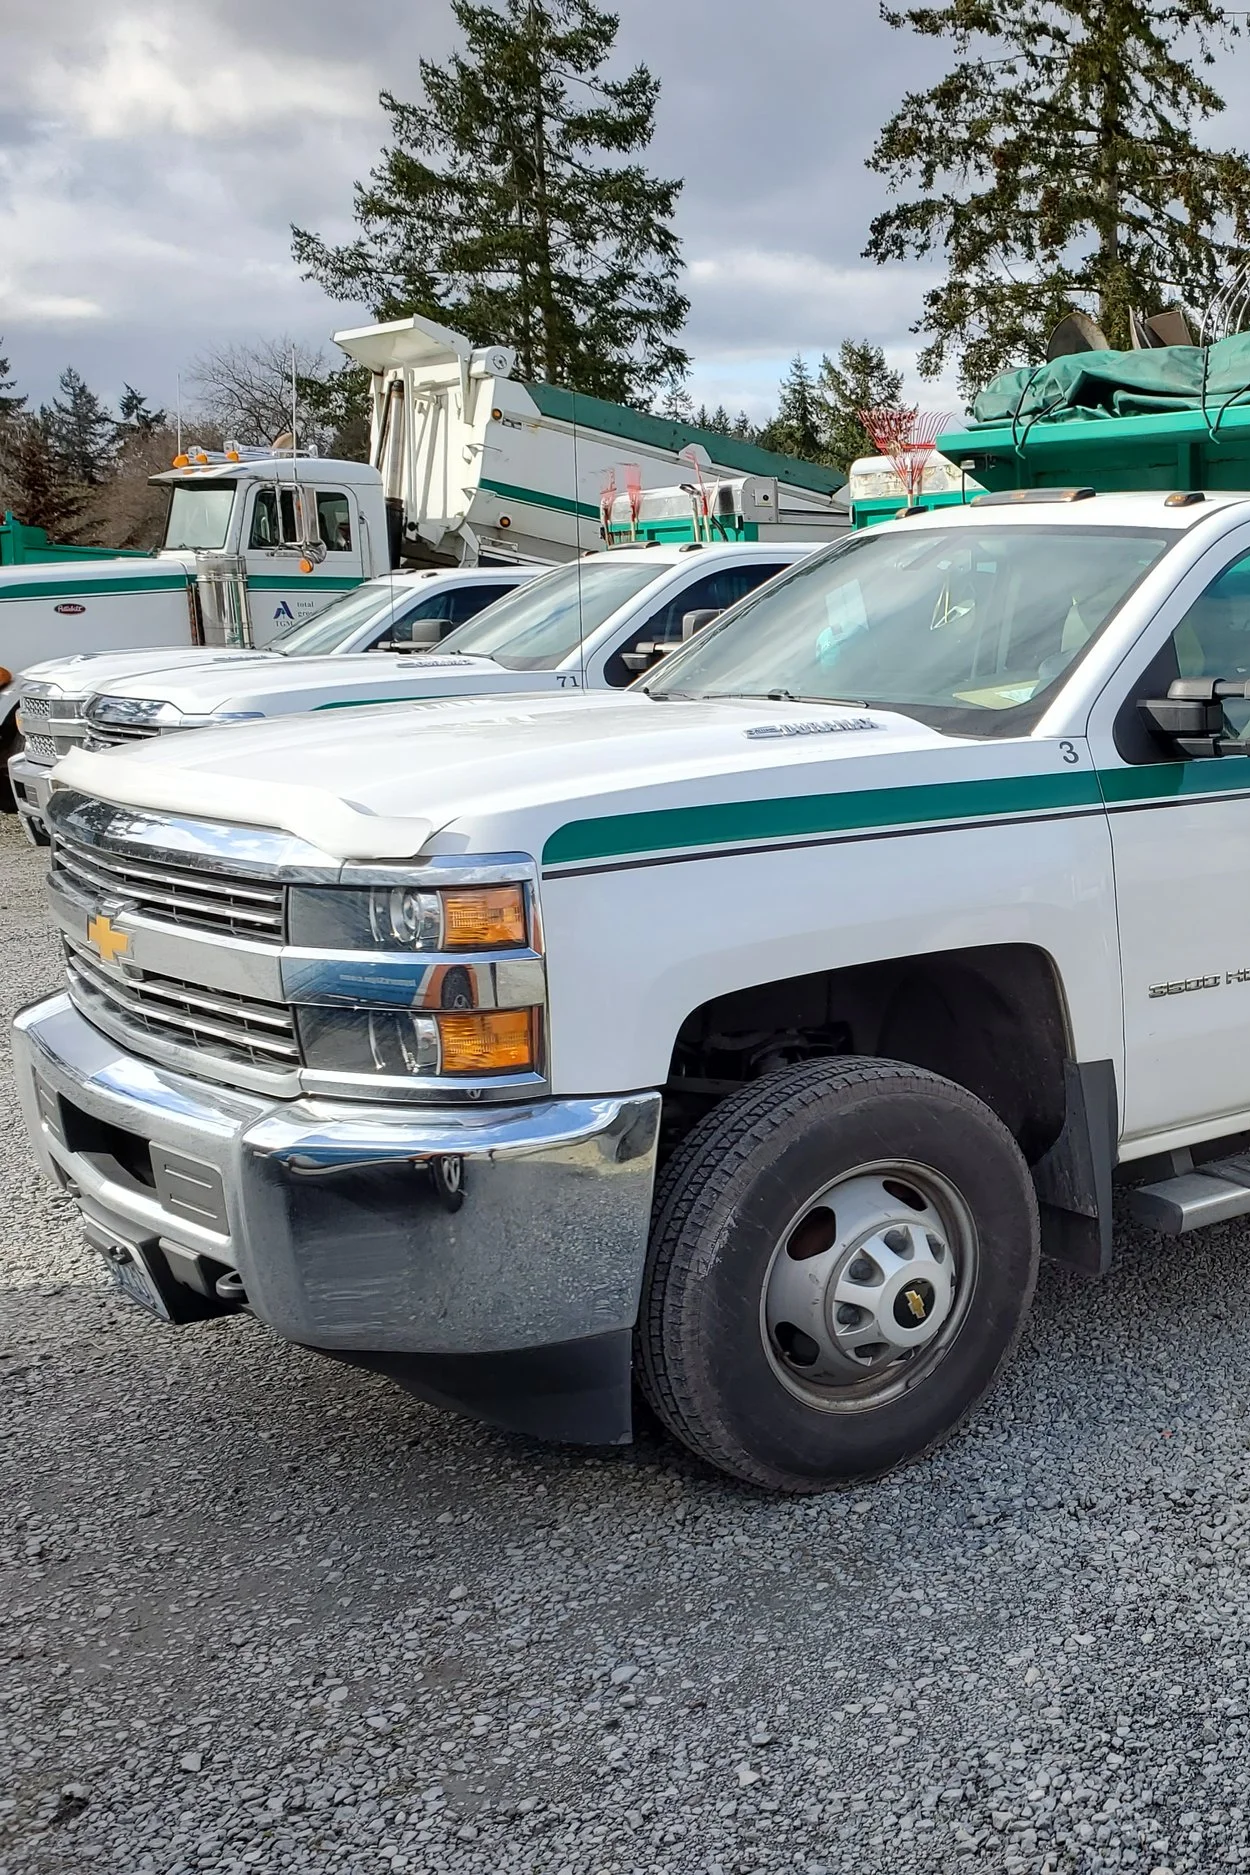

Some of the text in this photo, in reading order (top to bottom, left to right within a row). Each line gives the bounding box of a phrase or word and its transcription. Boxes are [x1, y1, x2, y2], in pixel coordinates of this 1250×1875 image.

[556, 675, 581, 688] 71
[780, 717, 879, 736] DURAMAX
[1059, 740, 1079, 764] 3
[1148, 974, 1220, 998] 3500
